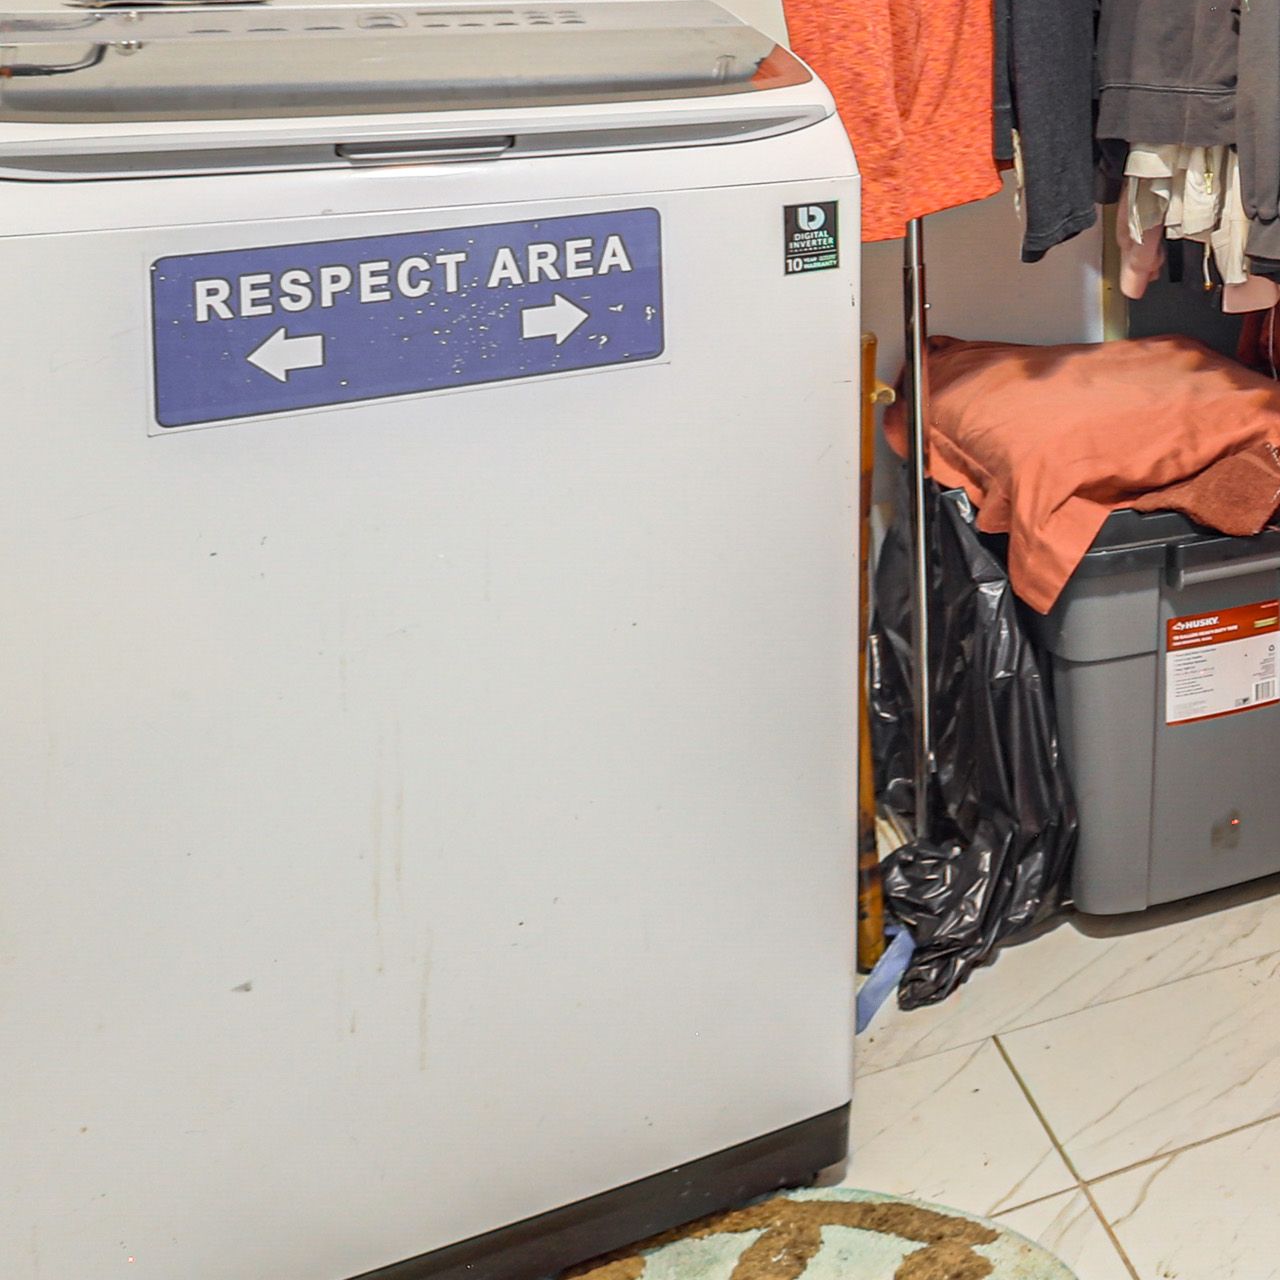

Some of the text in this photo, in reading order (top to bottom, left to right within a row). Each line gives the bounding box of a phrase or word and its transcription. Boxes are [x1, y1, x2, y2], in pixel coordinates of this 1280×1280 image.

[789, 236, 835, 249] INVERTER
[793, 230, 829, 241] DIGITAL
[786, 257, 803, 272] 10
[193, 234, 633, 324] RESPECT AREA
[1186, 616, 1219, 630] HUSKY
